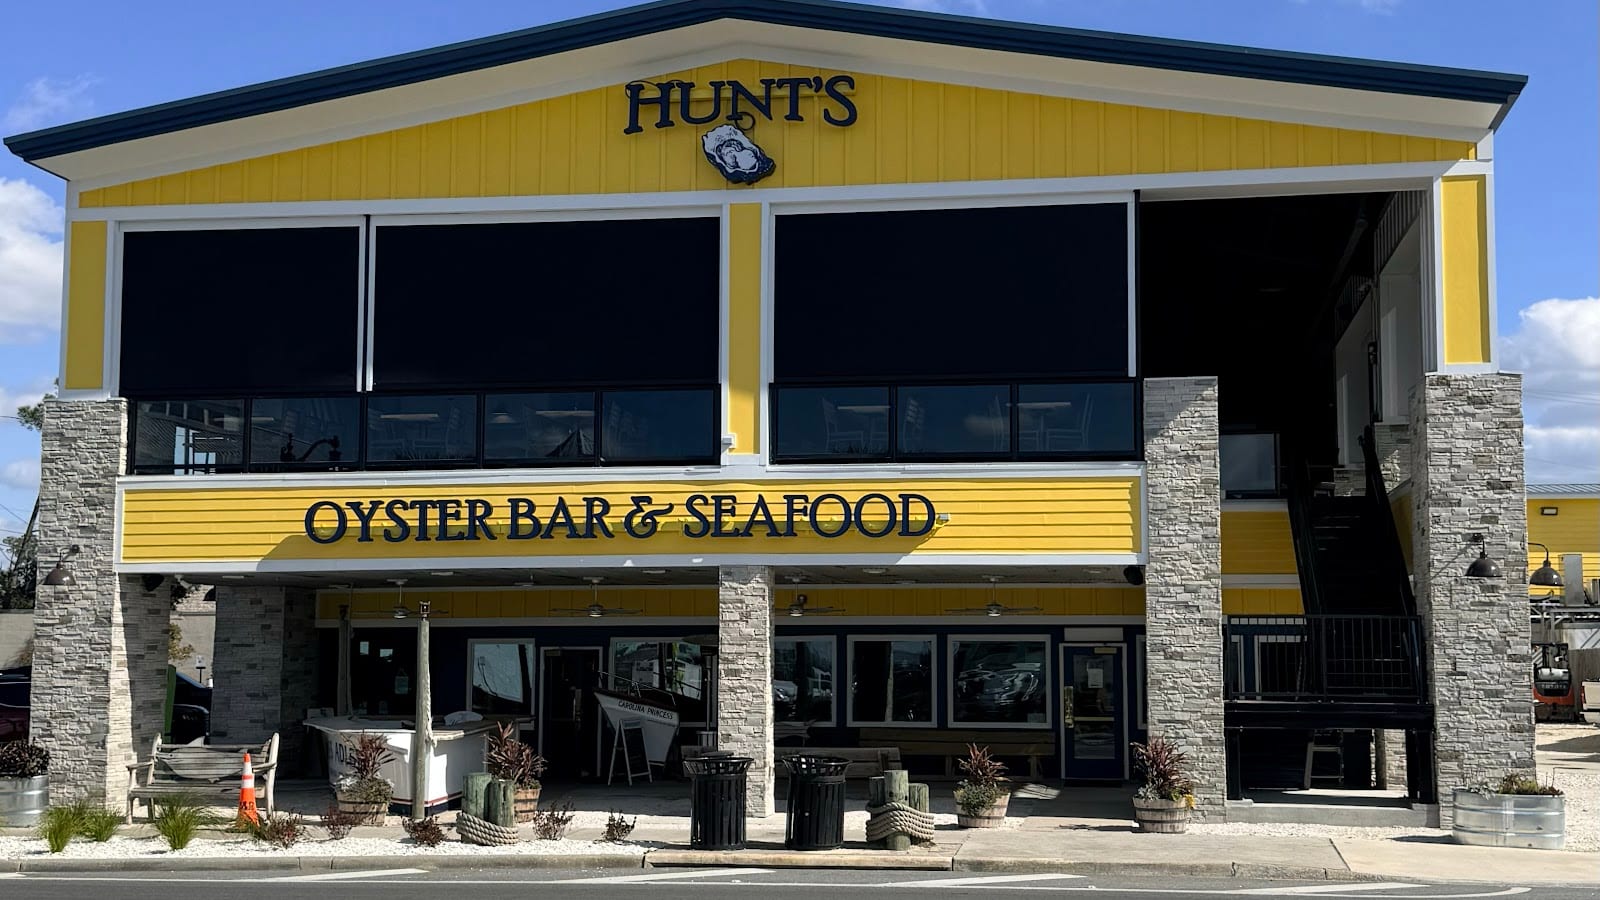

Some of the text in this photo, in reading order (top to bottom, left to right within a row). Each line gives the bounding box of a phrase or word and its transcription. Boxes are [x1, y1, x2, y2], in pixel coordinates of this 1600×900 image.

[623, 75, 858, 135] HUNT'S
[304, 493, 936, 544] OYSTER BAR & SEAFOOD
[618, 700, 673, 720] CAROLINA PRINCESS
